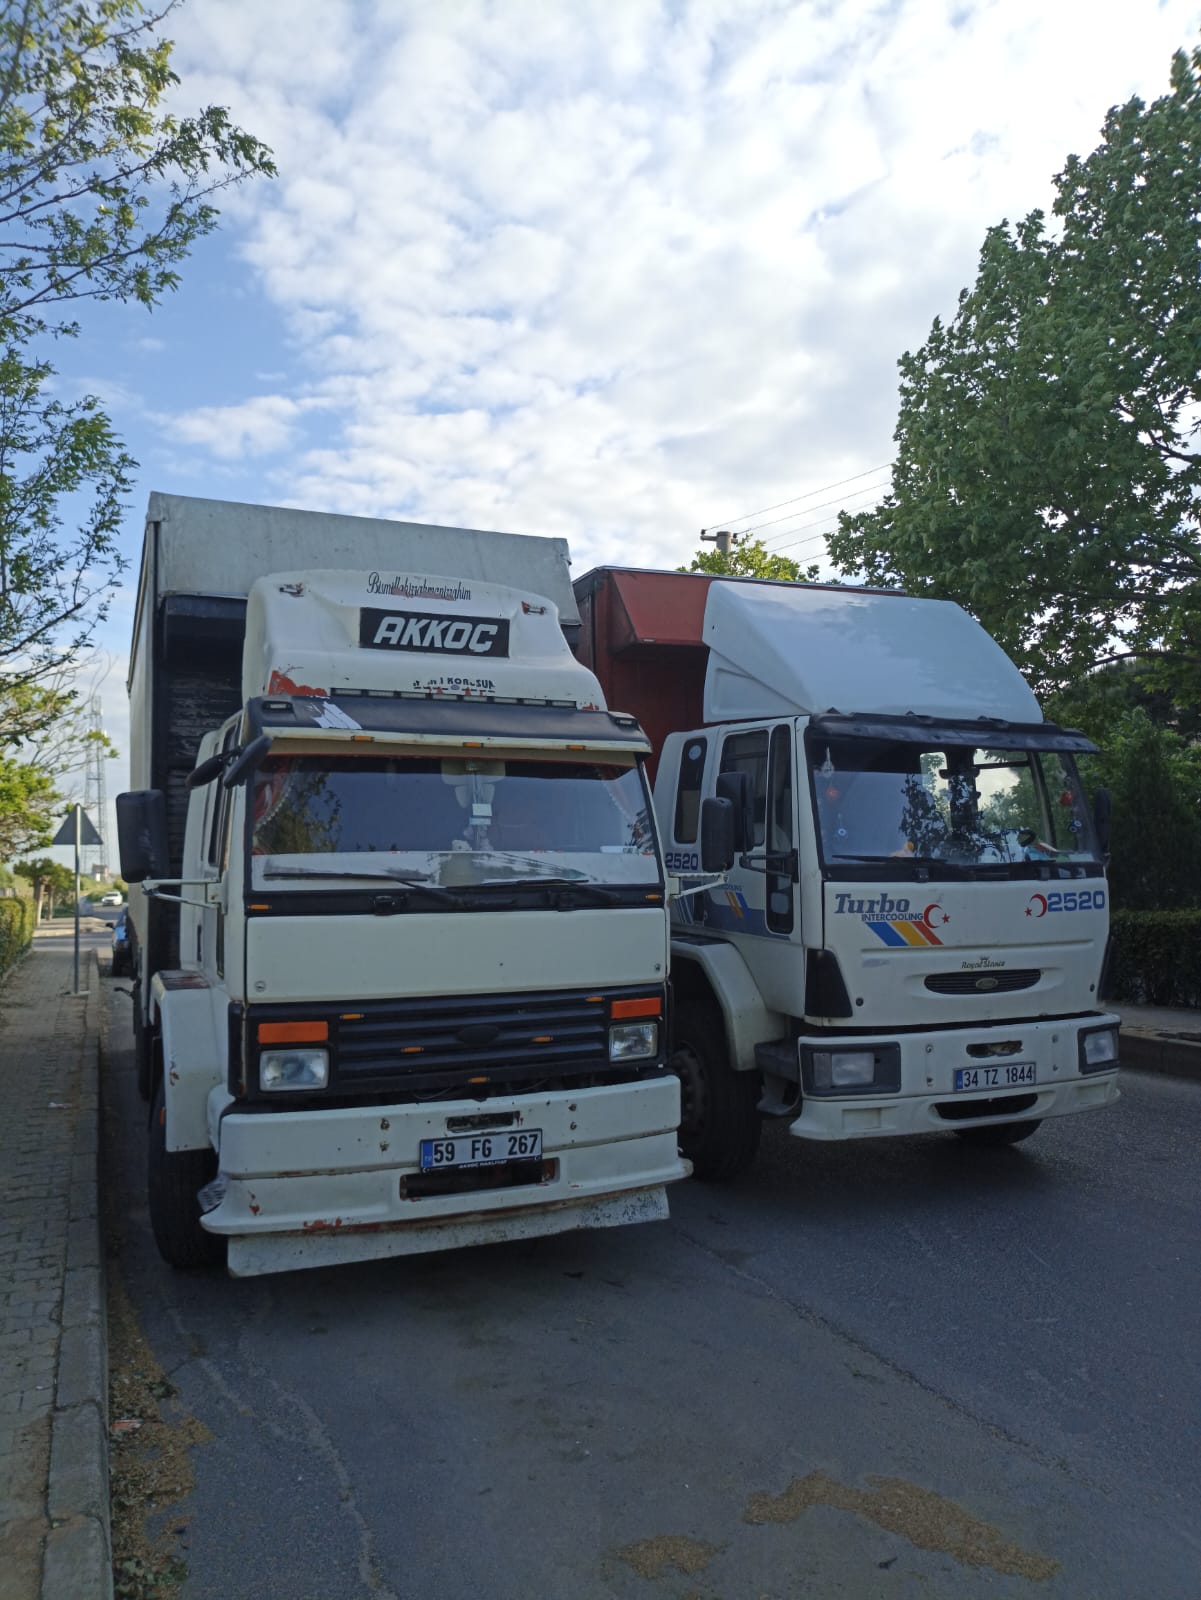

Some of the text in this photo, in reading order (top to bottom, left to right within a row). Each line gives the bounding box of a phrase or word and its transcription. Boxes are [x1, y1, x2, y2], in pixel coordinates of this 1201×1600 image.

[373, 616, 498, 653] AKKOÇ
[665, 852, 699, 871] 2520
[834, 892, 910, 914] Turbo
[1047, 890, 1106, 912] 2520
[861, 912, 924, 922] INTERCOOLING
[963, 1071, 978, 1088] 34
[984, 1069, 998, 1086] TZ
[1005, 1066, 1033, 1083] 1844
[433, 1142, 455, 1164] 59
[471, 1138, 492, 1160] FG
[507, 1133, 539, 1156] 267
